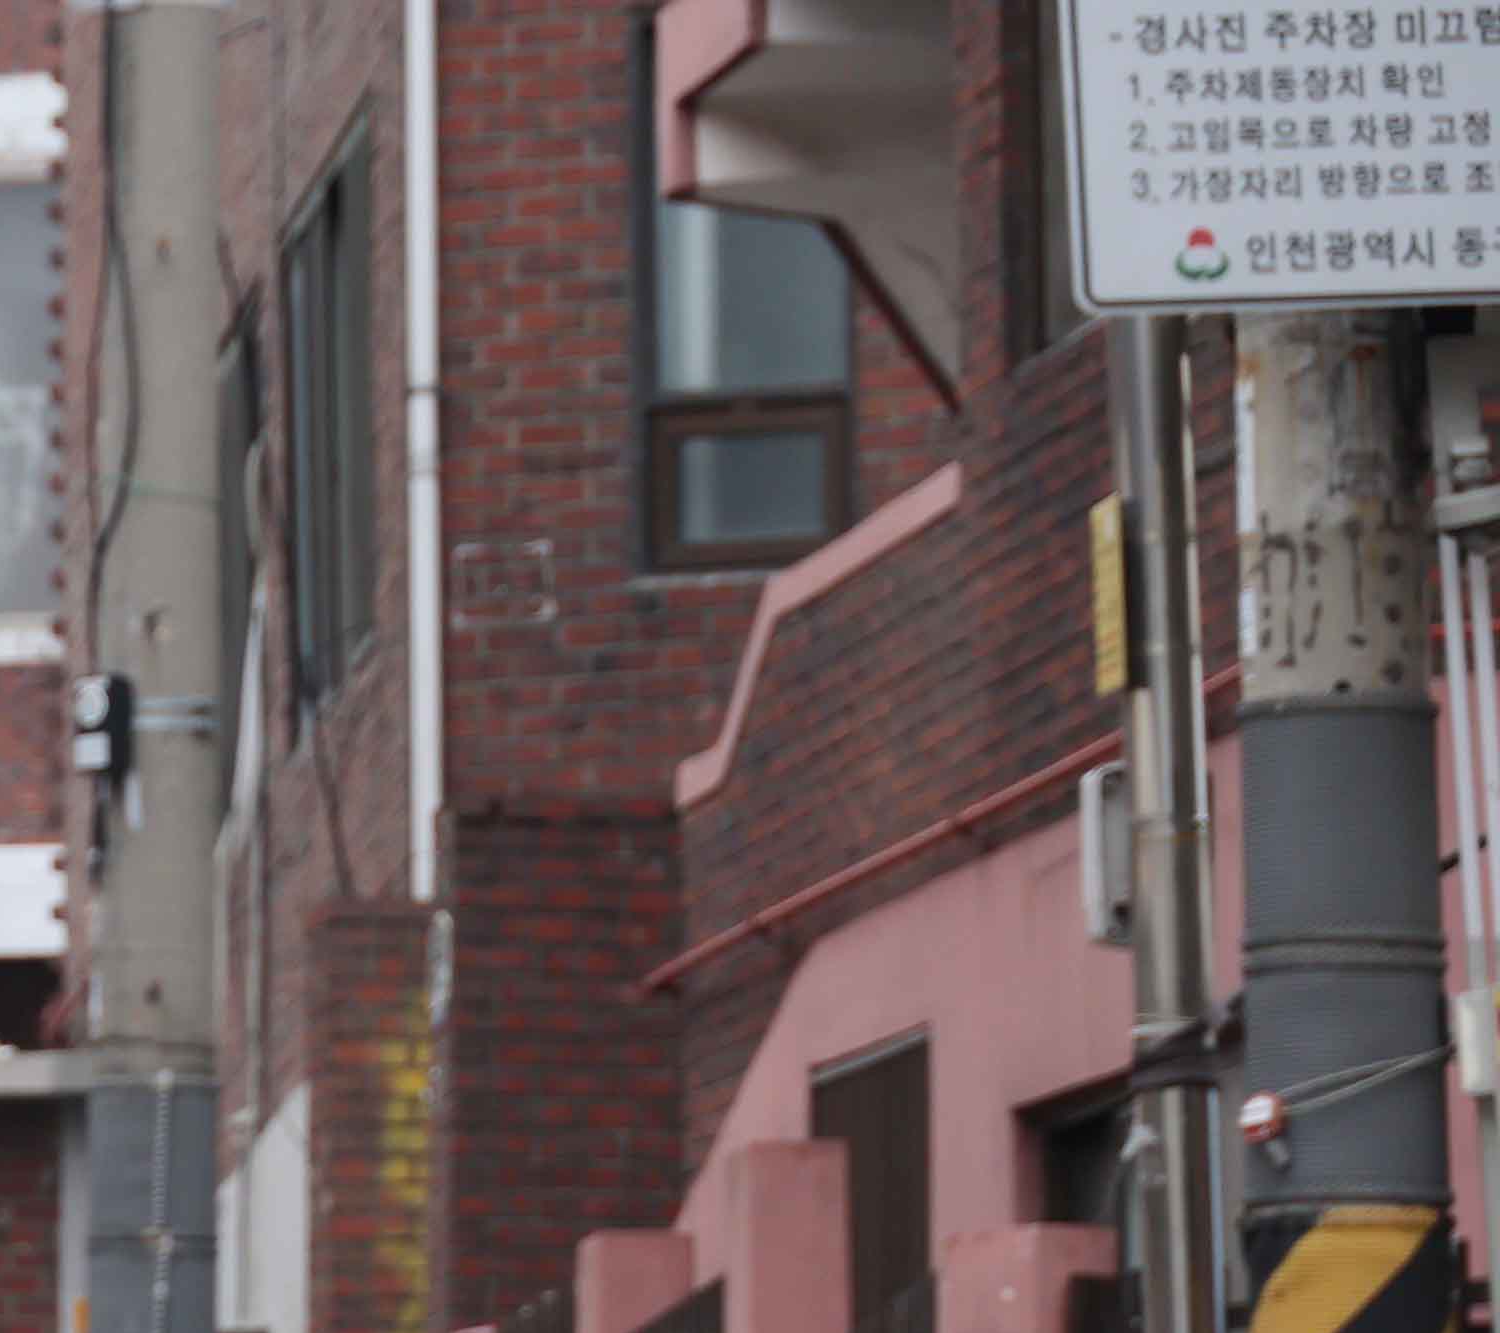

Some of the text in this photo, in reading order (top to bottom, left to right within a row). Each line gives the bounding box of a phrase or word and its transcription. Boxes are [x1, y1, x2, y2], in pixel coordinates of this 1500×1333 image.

[1134, 14, 1248, 55] 경사진
[1264, 10, 1377, 51] 주차장
[1166, 65, 1367, 103] 주차제동장치
[1381, 61, 1446, 99] 확인
[1167, 116, 1337, 155] 고임목으로
[1348, 112, 1414, 149] 차량
[1428, 109, 1491, 147] 고정
[1170, 167, 1304, 203] 가장자리
[1318, 162, 1451, 200] 방향으로
[1465, 161, 1500, 194] 조
[1246, 226, 1500, 274] 인천광역시 동
